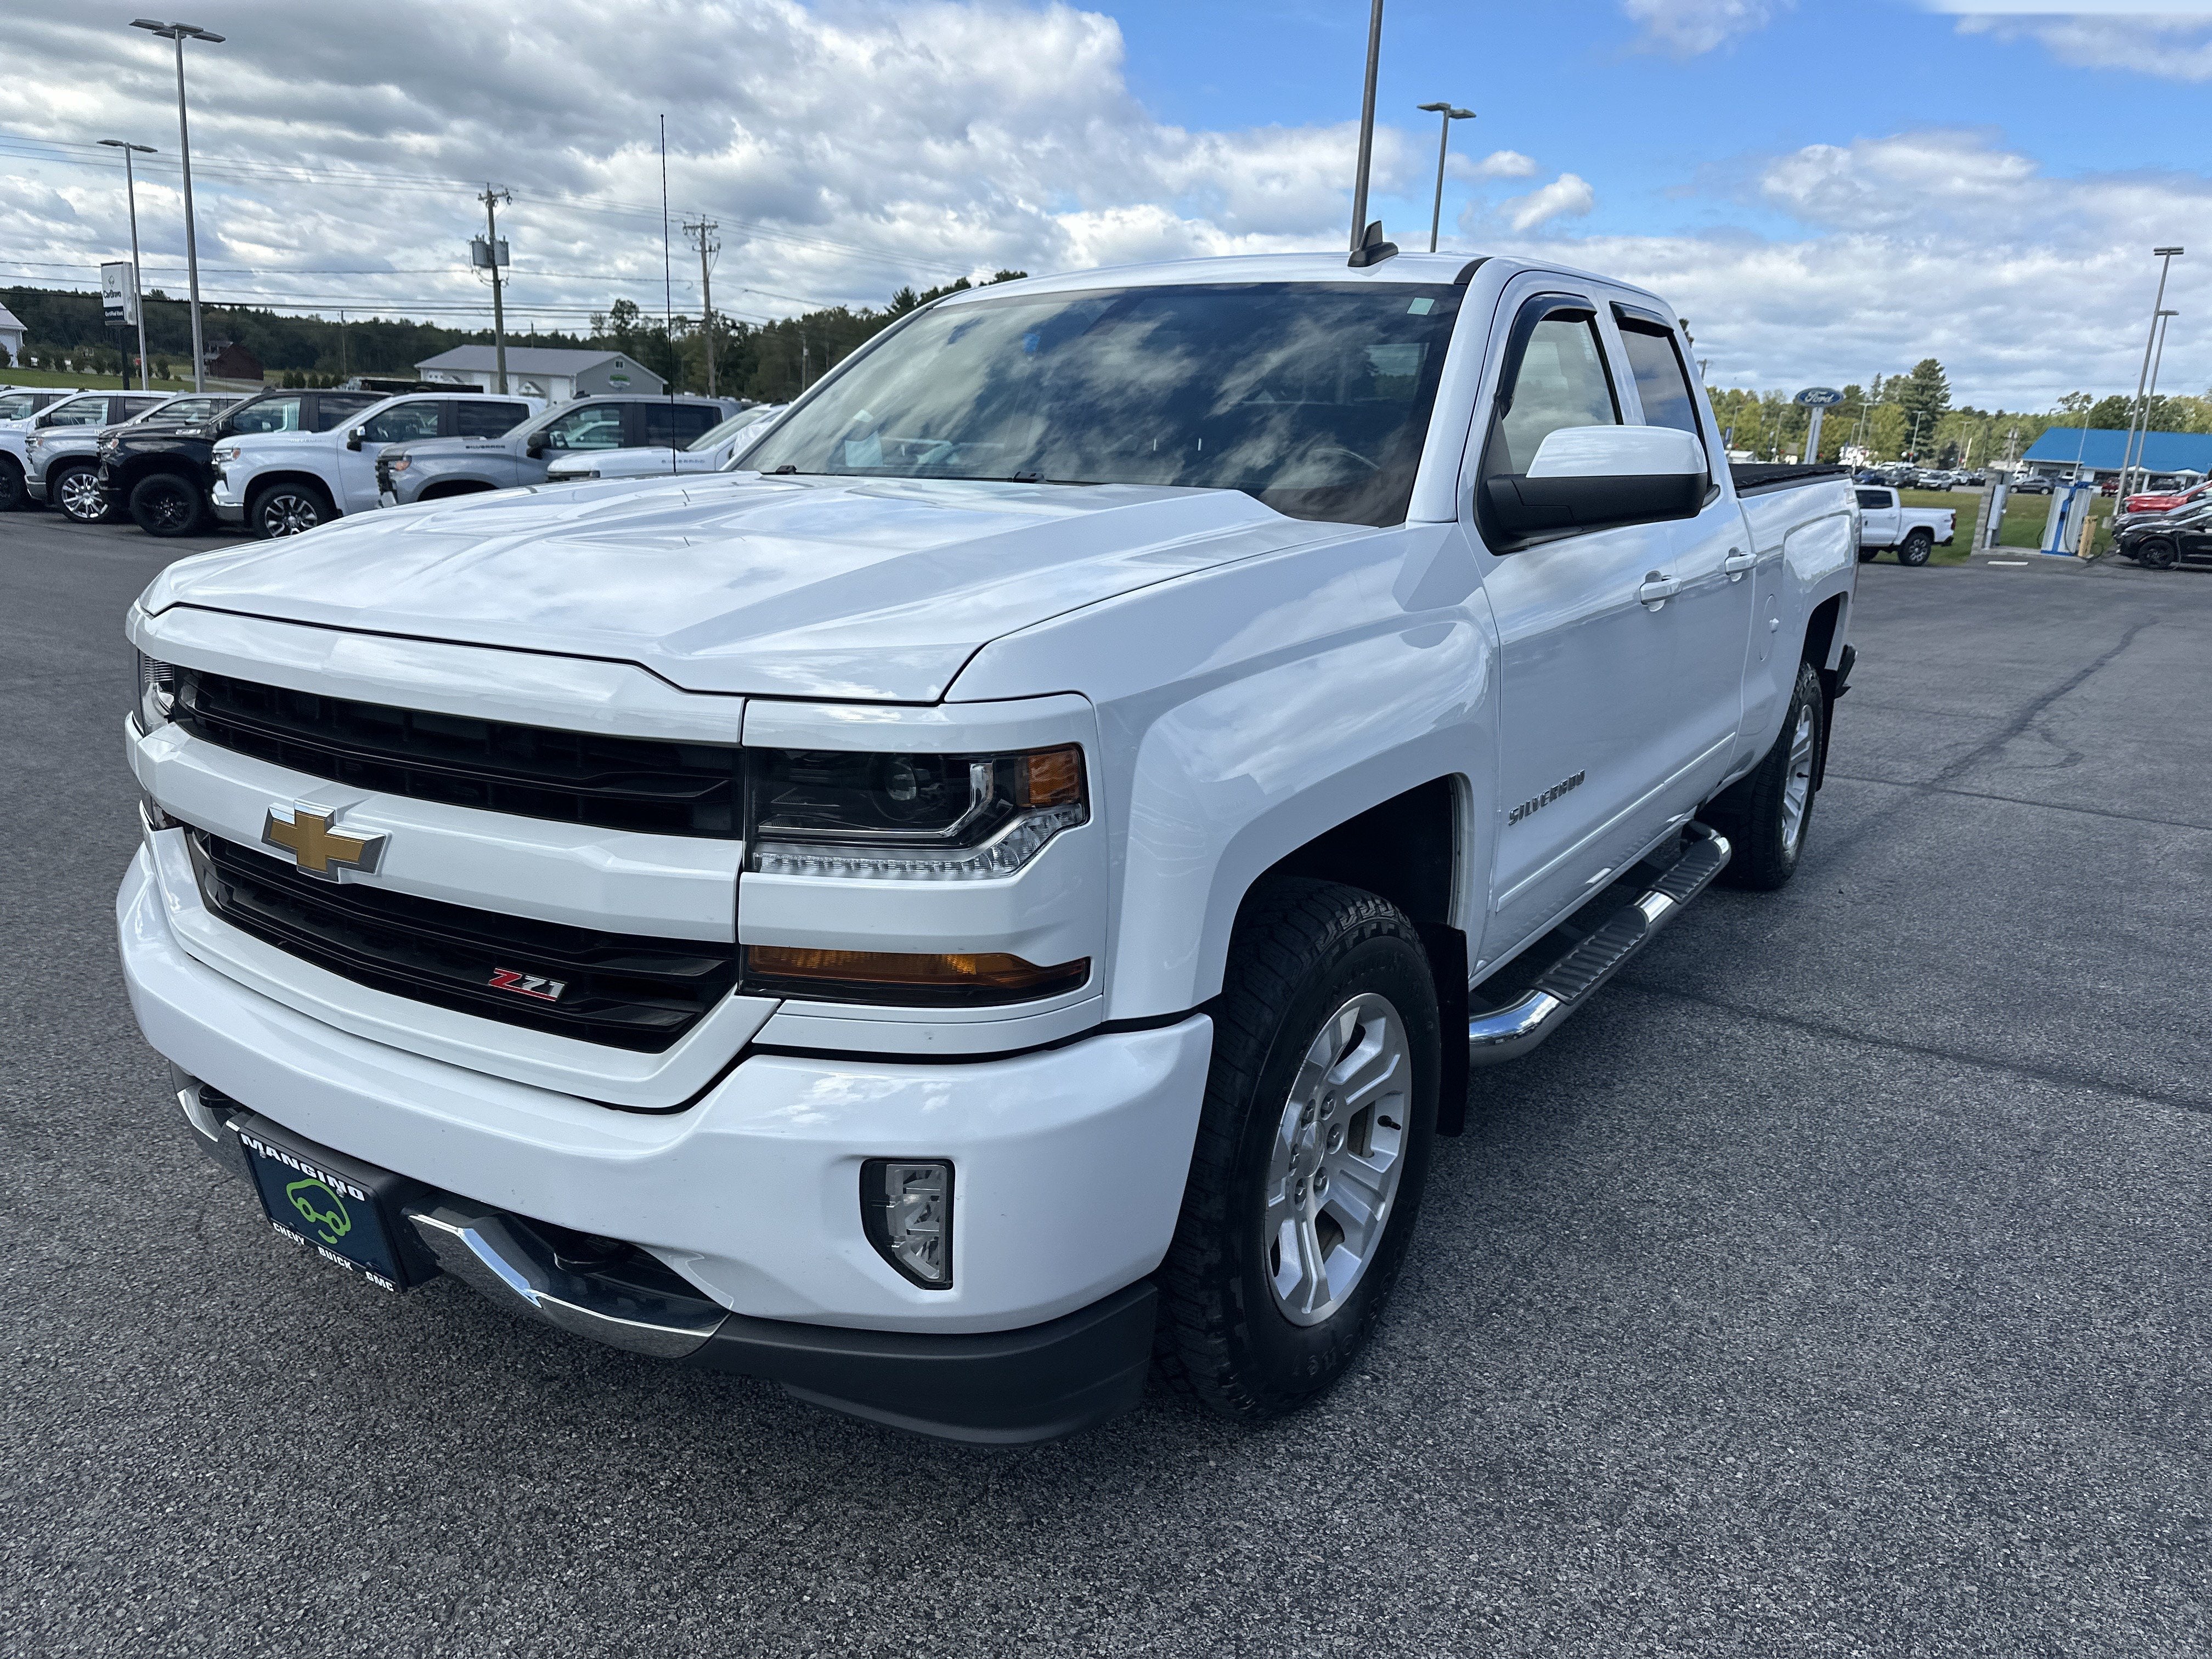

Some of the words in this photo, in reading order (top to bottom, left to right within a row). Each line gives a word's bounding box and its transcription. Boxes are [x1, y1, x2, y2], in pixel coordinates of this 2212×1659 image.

[1805, 390, 1835, 403] Ford
[1508, 769, 1585, 826] SILVERADO
[488, 967, 567, 1002] Z71
[240, 1133, 365, 1201] MANGINO
[273, 1222, 305, 1245] CHEVY
[317, 1246, 353, 1271] BUICK
[365, 1271, 394, 1292] GMC
